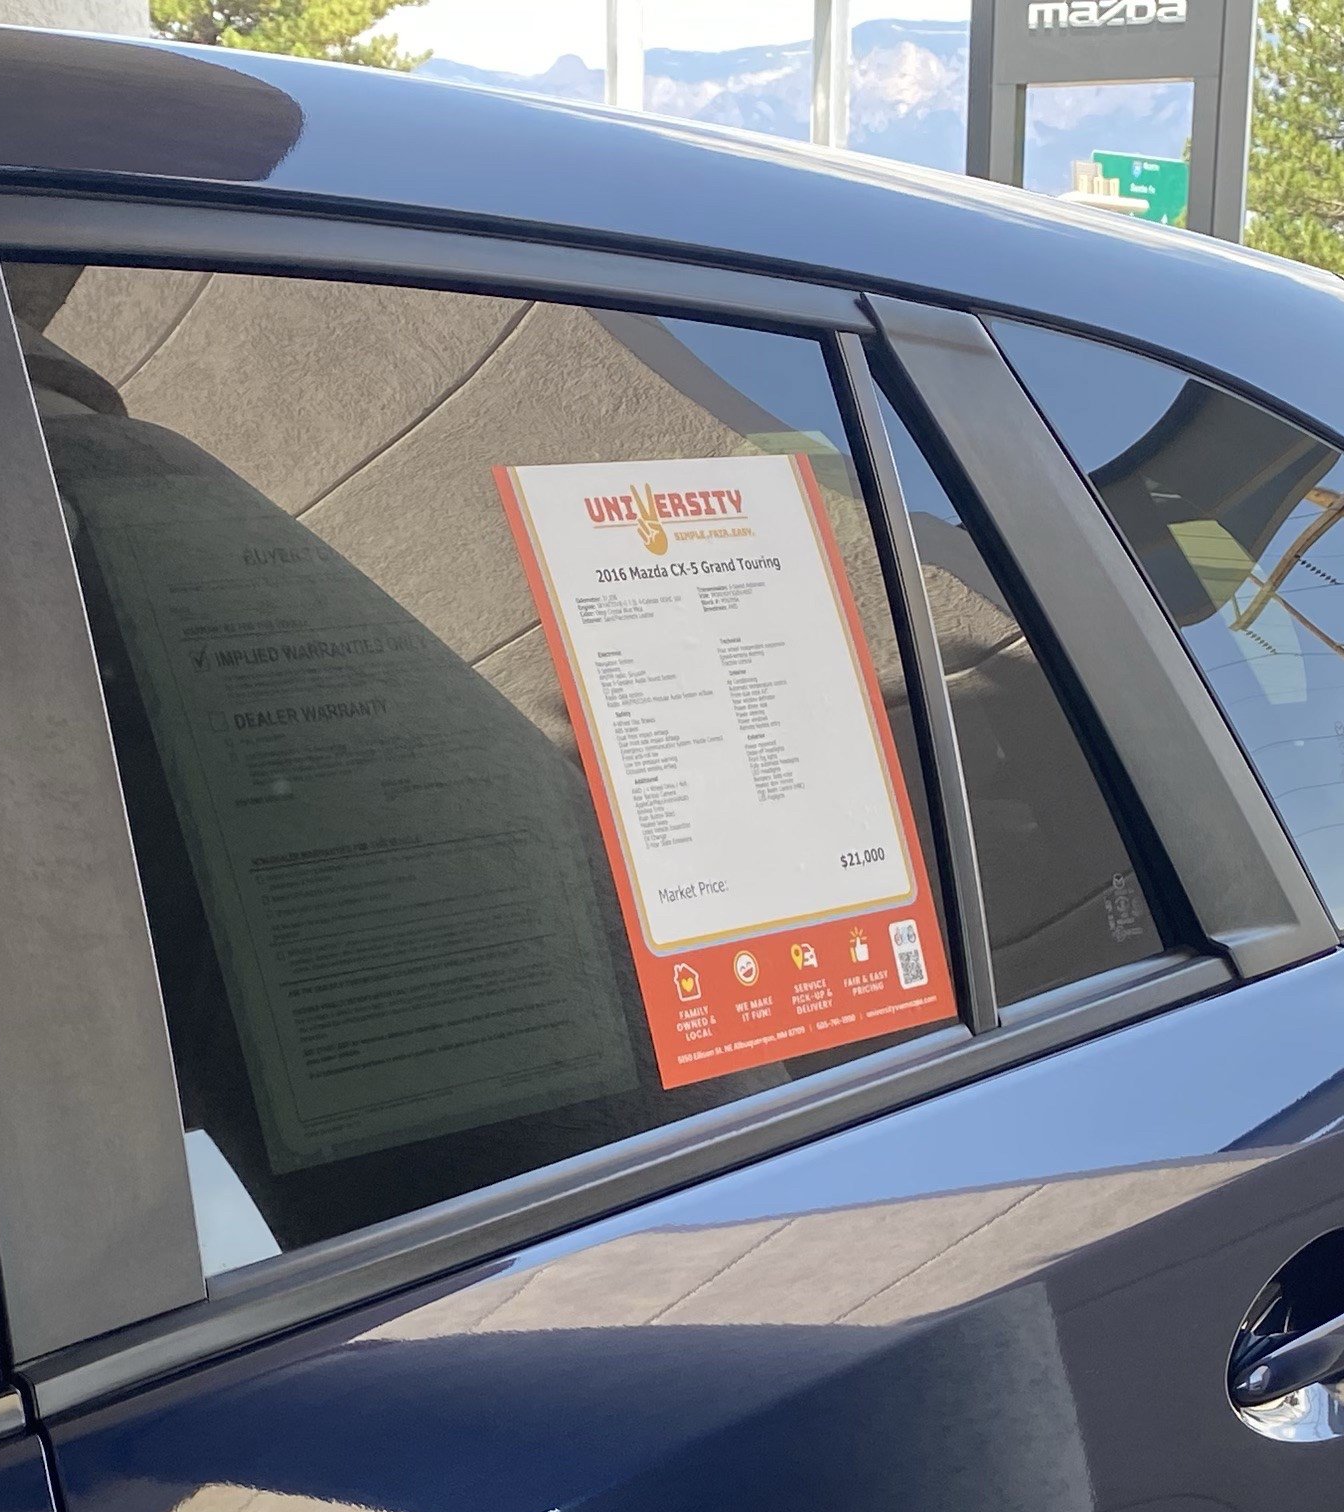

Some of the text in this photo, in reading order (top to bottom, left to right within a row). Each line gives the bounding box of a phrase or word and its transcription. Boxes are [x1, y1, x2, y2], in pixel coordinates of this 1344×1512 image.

[1027, 0, 1188, 29] mazda
[596, 555, 781, 584] 2016 Mazda CX-5 Grand Touring
[216, 646, 279, 668] IMPLIED
[282, 638, 385, 663] WARRANTIES
[233, 699, 389, 731] DEALER WARRANTY
[839, 846, 886, 869] $21,000
[658, 878, 730, 905] Market Price:
[794, 978, 827, 994] SERVICE
[843, 977, 862, 989] FAIR
[868, 969, 889, 982] EASY
[852, 981, 885, 997] PRICING
[735, 996, 773, 1013] WE MAKE
[792, 990, 827, 1006] PICK-UP
[679, 1005, 709, 1020] FAMILY
[742, 1007, 772, 1022] IT FUN!
[796, 999, 833, 1015] DELIVERY
[676, 1017, 708, 1032] OWNED
[685, 1027, 713, 1042] LOCAL
